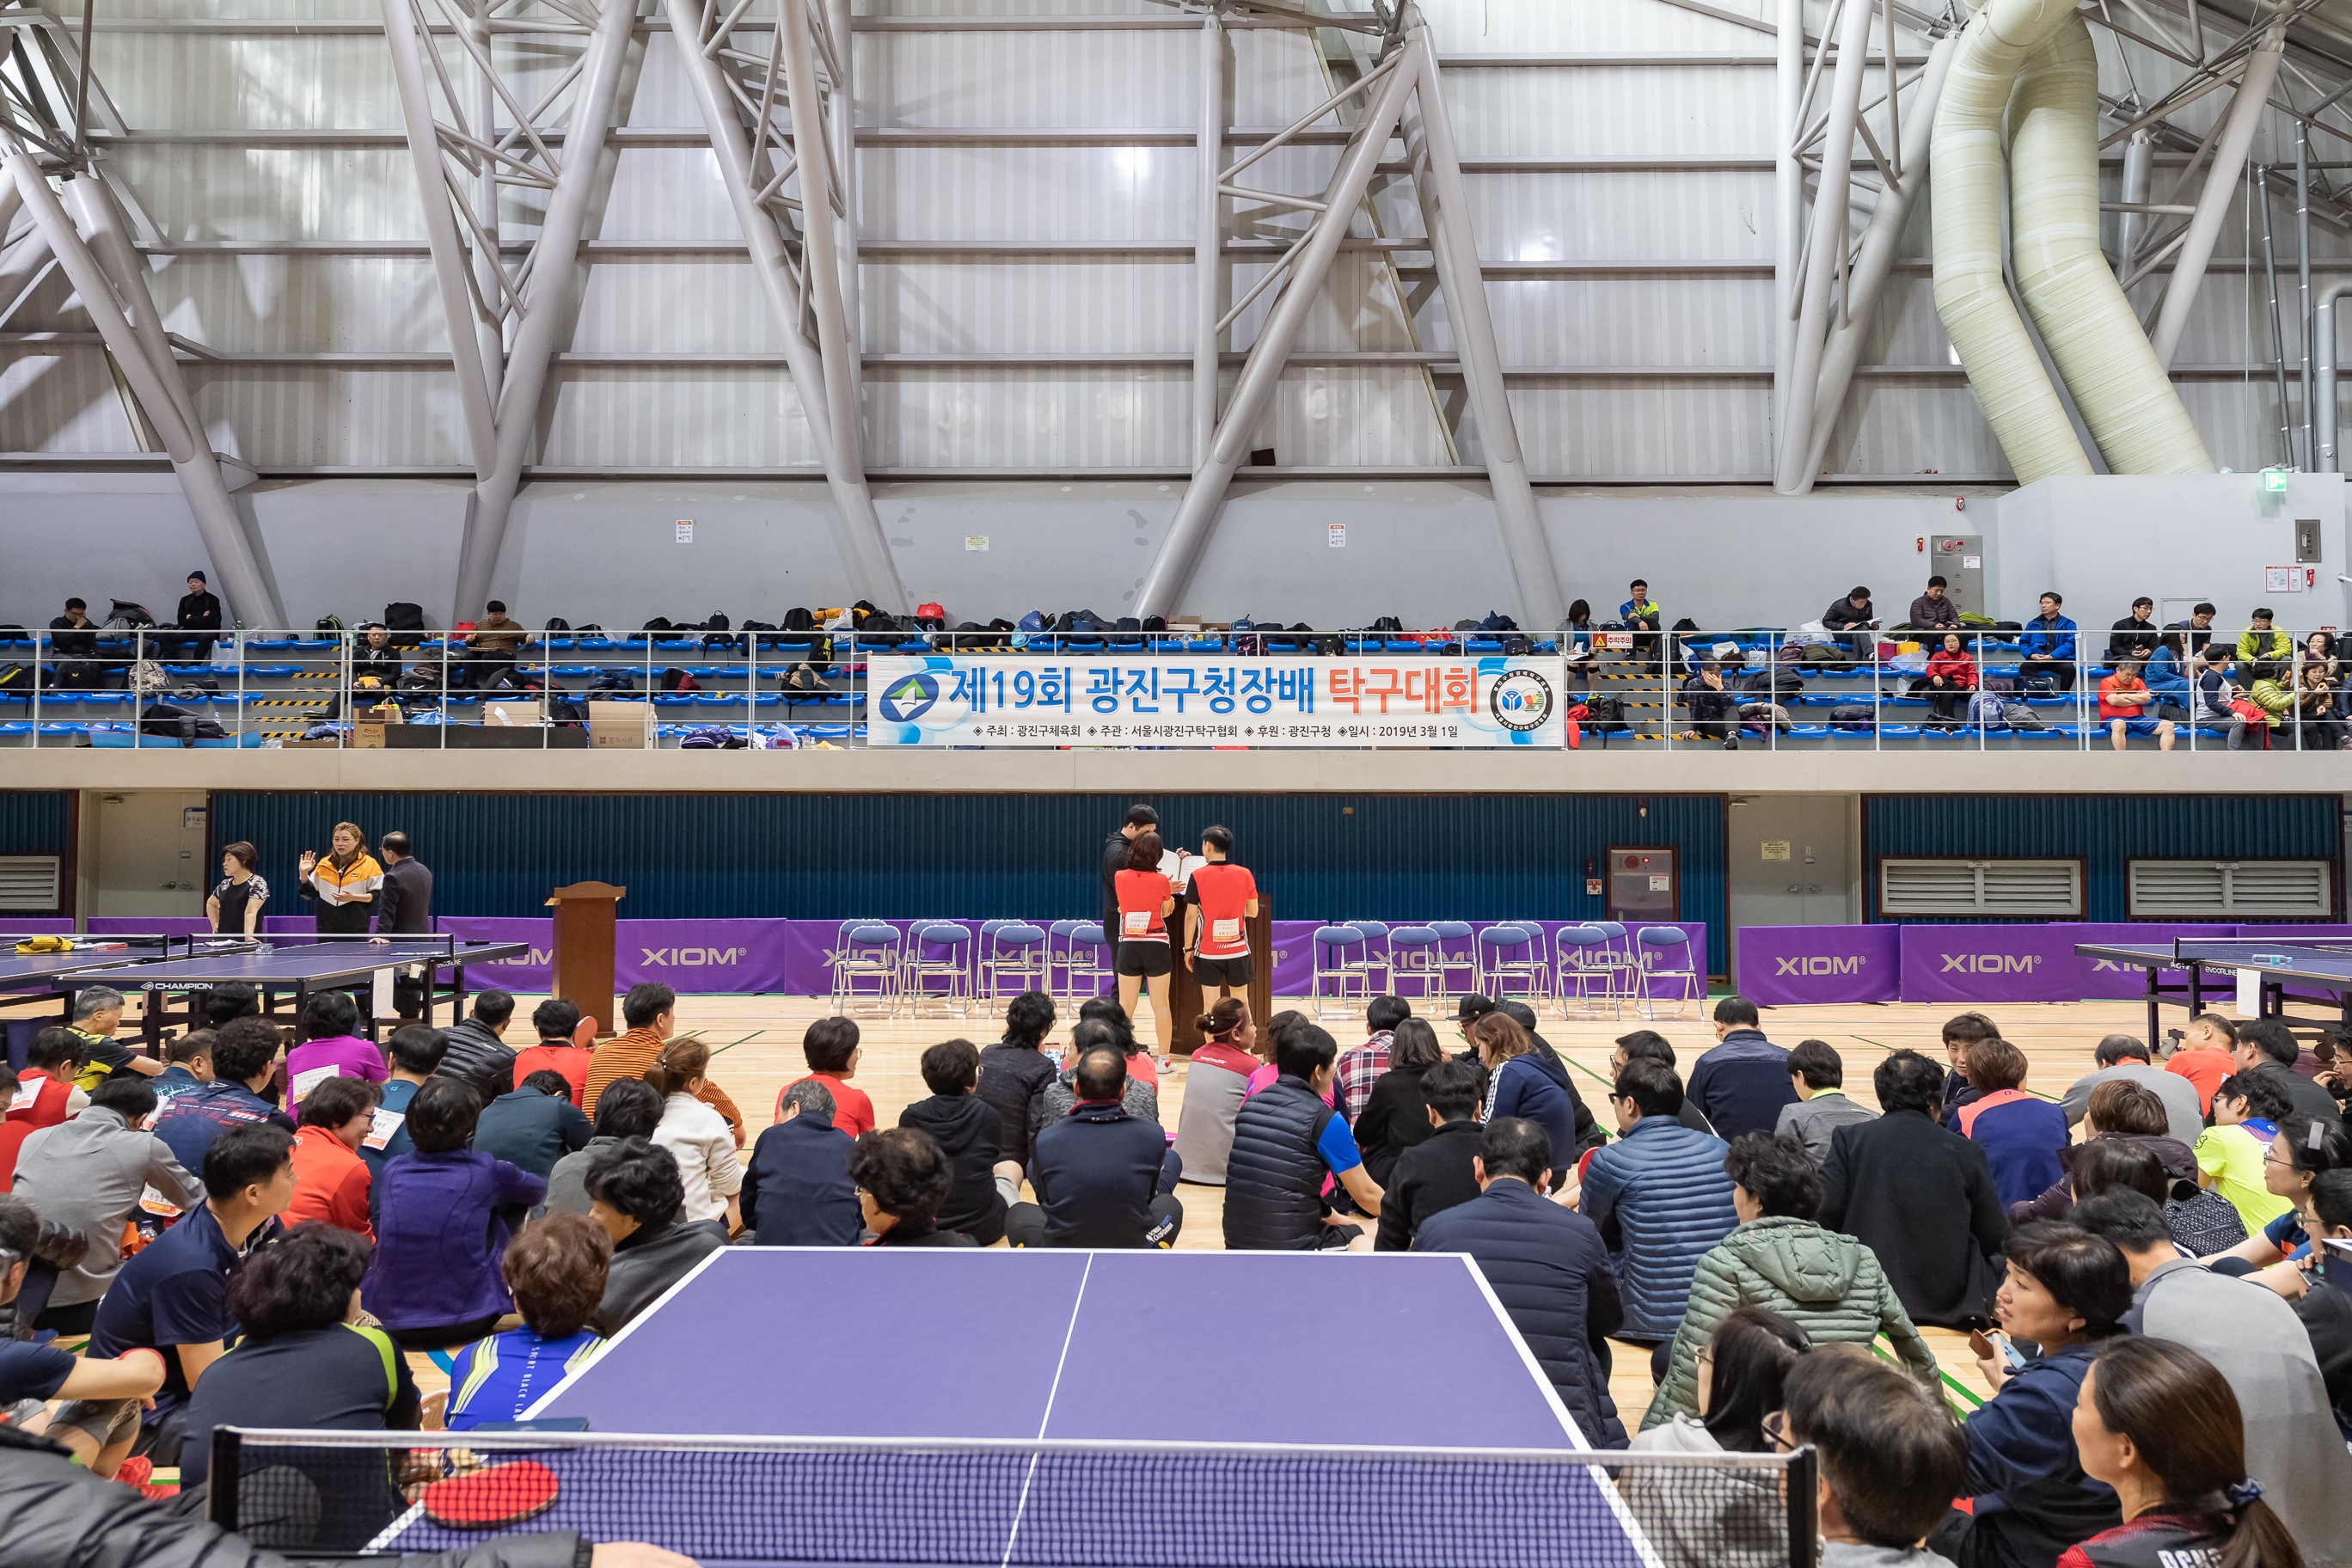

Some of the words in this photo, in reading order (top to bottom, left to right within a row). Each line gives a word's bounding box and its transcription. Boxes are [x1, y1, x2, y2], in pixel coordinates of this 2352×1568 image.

[948, 666, 1071, 714] 제19회
[1085, 666, 1314, 714] 광진구청장배
[1329, 666, 1479, 714] 탁구대회
[986, 725, 1008, 738] 주최
[1016, 725, 1081, 738] 광진구체육회
[1099, 725, 1123, 738] 주관
[1131, 725, 1238, 738] 서울시광진구탁구협회
[1257, 725, 1279, 738] 후원
[1288, 725, 1331, 738] 광진구청
[1348, 725, 1369, 738] 일시
[1379, 725, 1418, 738] 2019년
[1420, 725, 1438, 738] 3월
[1441, 725, 1459, 738] 1일
[518, 1373, 533, 1399] BLACK
